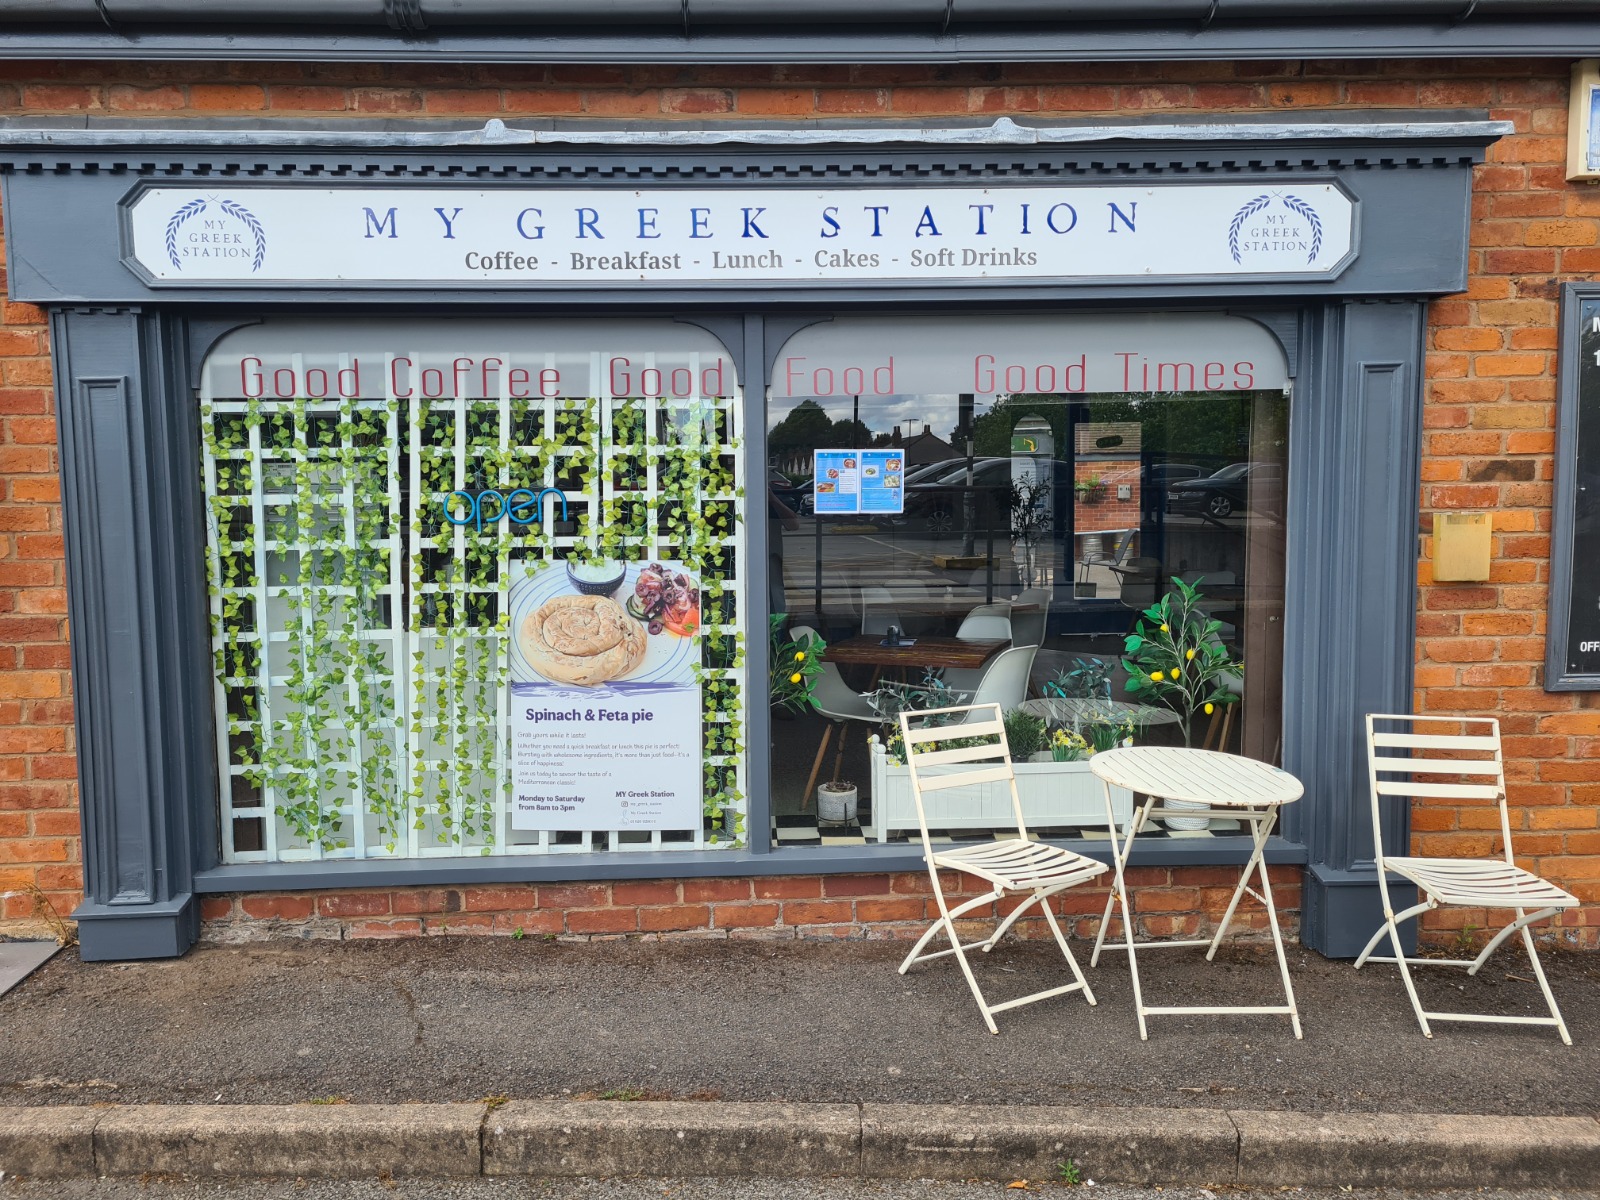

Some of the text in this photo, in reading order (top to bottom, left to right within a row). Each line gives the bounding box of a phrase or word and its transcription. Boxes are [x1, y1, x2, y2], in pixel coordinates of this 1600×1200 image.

[204, 220, 226, 230] MY
[362, 202, 1138, 240] MY GREEK STATION
[1266, 215, 1287, 225] MY
[189, 233, 242, 244] GREEK
[1251, 228, 1301, 238] GREEK
[1243, 241, 1307, 252] STATION
[182, 247, 251, 258] STATION
[464, 251, 539, 270] Coffee
[570, 251, 682, 270] Breakfast
[712, 249, 783, 269] Lunch
[814, 248, 880, 268] Cakes
[910, 247, 955, 267] Soft
[961, 246, 1038, 267] Drinks
[240, 352, 1255, 398] Good Coffee Good Food Good Times
[443, 487, 568, 532] open
[1580, 641, 1600, 652] OFF
[525, 708, 654, 724] Spinach & Feta pie
[518, 794, 545, 803] Monday
[554, 795, 585, 803] Saturday
[627, 790, 649, 798] Greek
[650, 790, 675, 798] Station
[518, 803, 535, 811] from
[559, 804, 576, 812] 3pm
